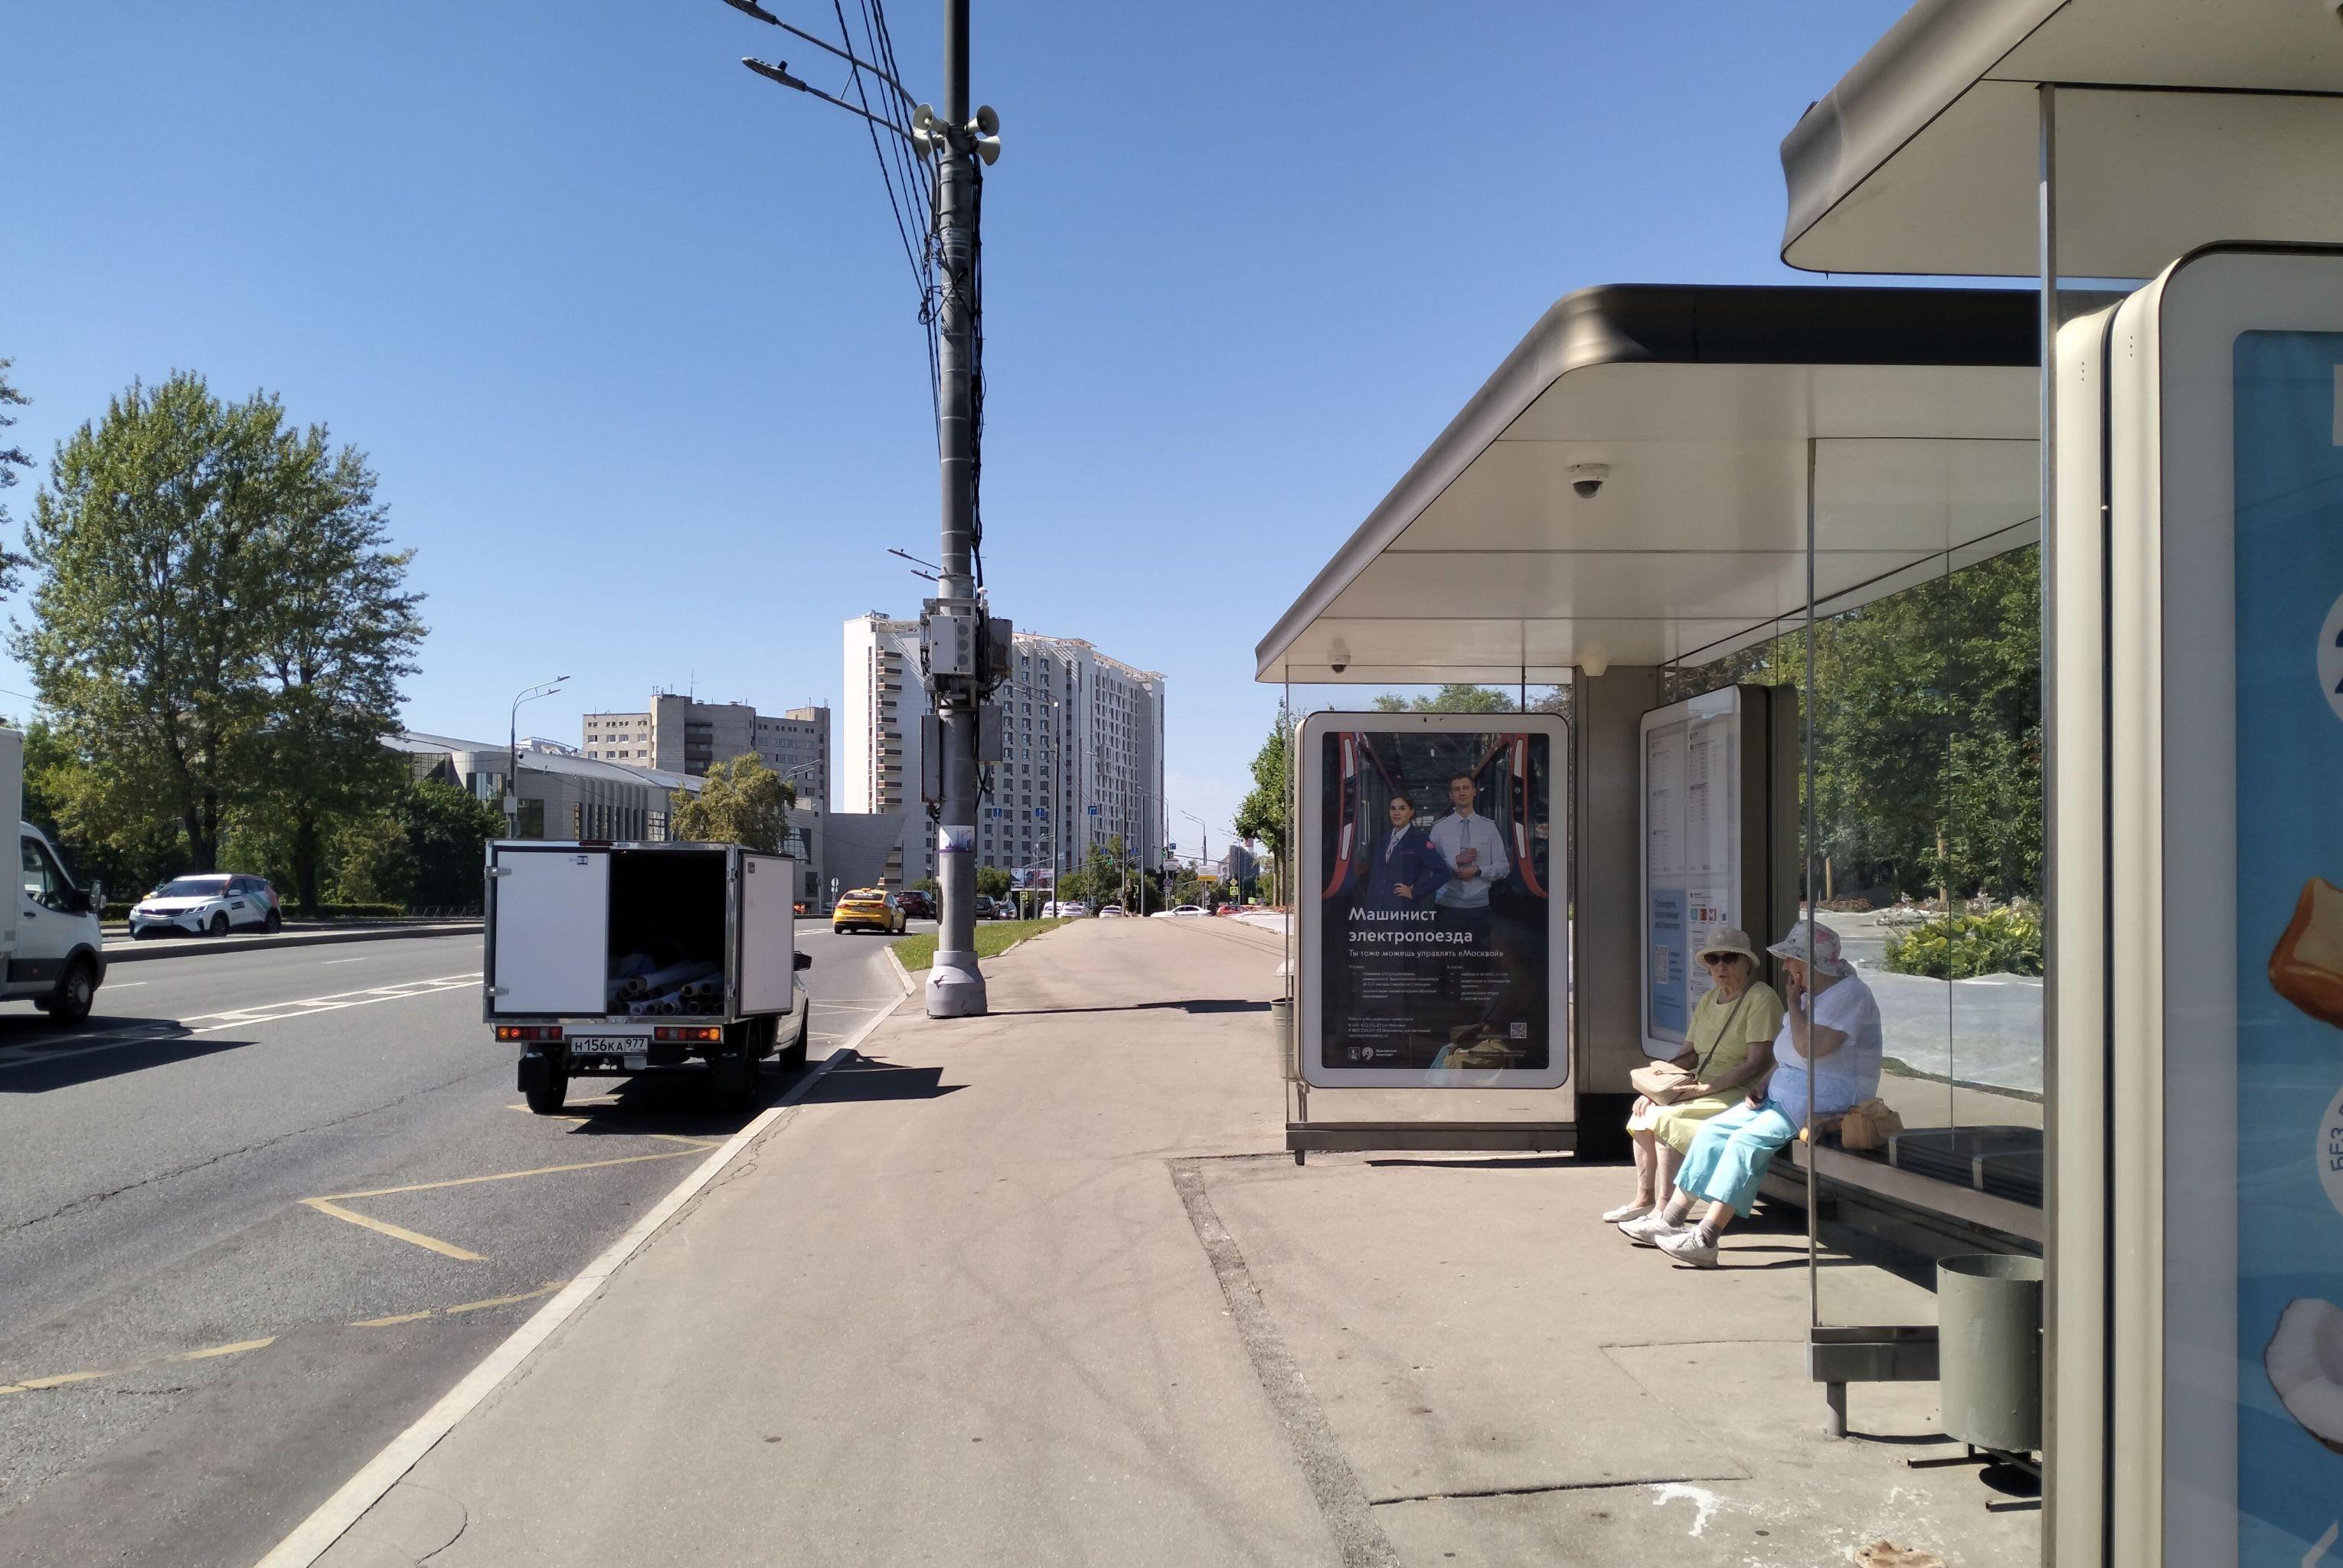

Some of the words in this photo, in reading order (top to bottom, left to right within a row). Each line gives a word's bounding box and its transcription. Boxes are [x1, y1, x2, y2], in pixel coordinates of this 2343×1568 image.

[1348, 906, 1437, 921] Машинист
[1348, 931, 1472, 945] электропоезда
[626, 1038, 645, 1048] 977
